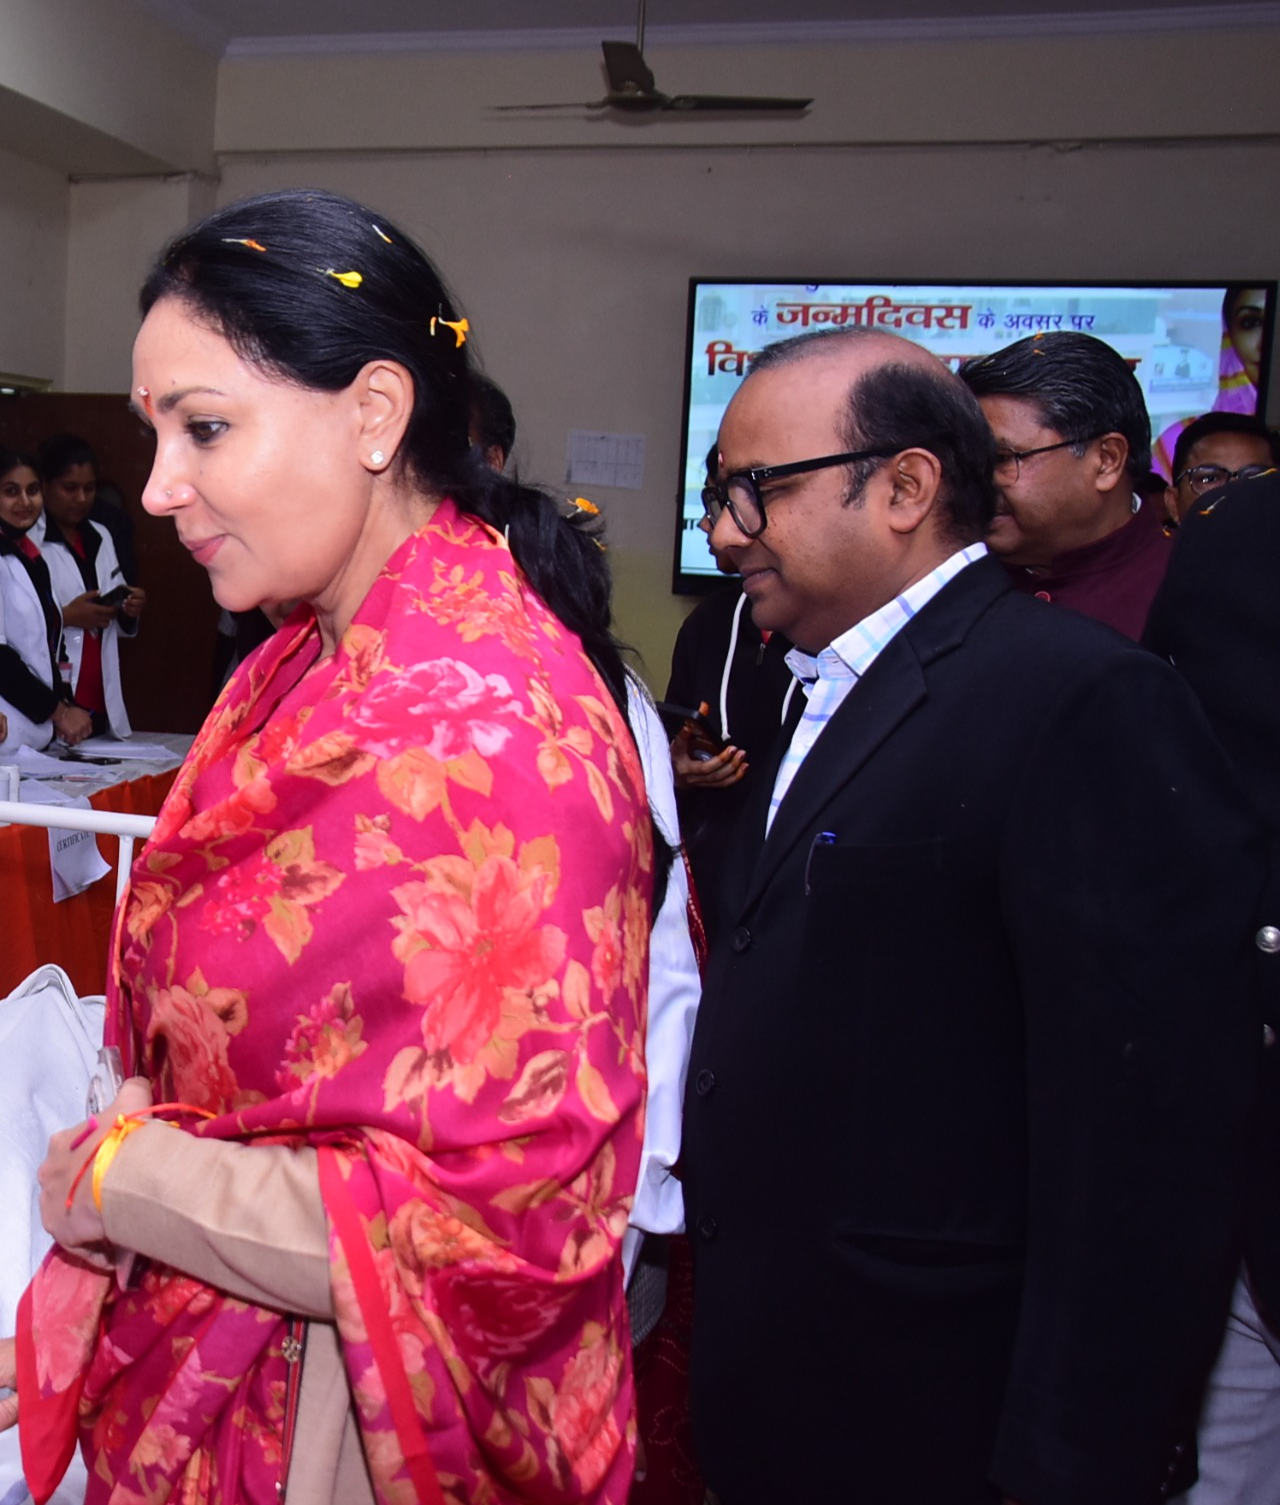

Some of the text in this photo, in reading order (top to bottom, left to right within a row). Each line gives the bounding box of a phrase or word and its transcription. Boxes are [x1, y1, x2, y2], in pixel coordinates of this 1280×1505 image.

[752, 295, 1095, 332] के जन्मदिवस के अवसर पर
